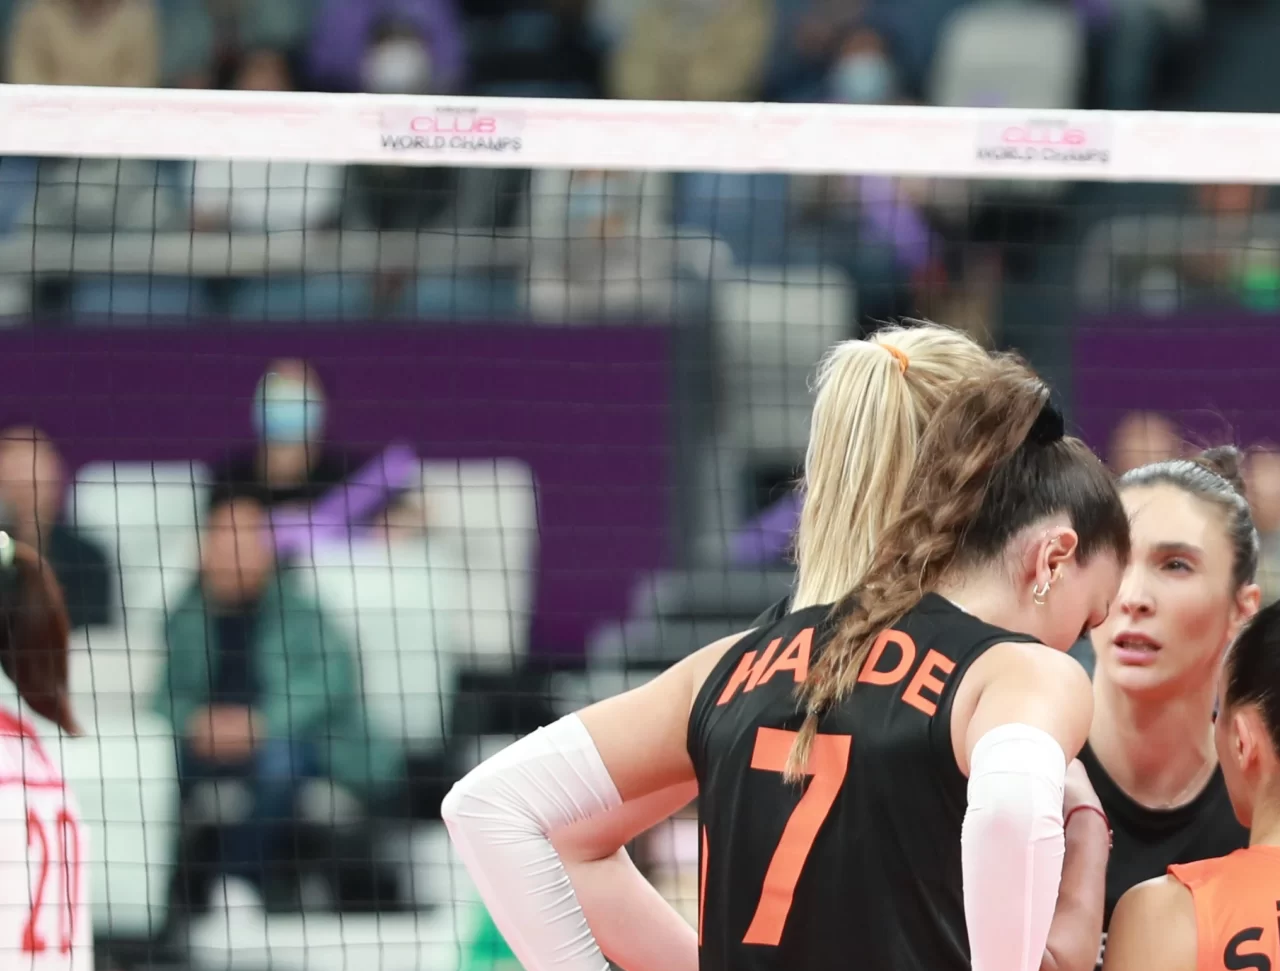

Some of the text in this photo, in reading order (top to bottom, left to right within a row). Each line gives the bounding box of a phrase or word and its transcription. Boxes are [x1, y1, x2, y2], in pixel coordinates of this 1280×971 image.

[380, 135, 445, 149] WORLD
[411, 116, 496, 133] CLUB
[716, 627, 957, 717] HADE
[20, 806, 80, 954] 20
[741, 726, 852, 946] 7
